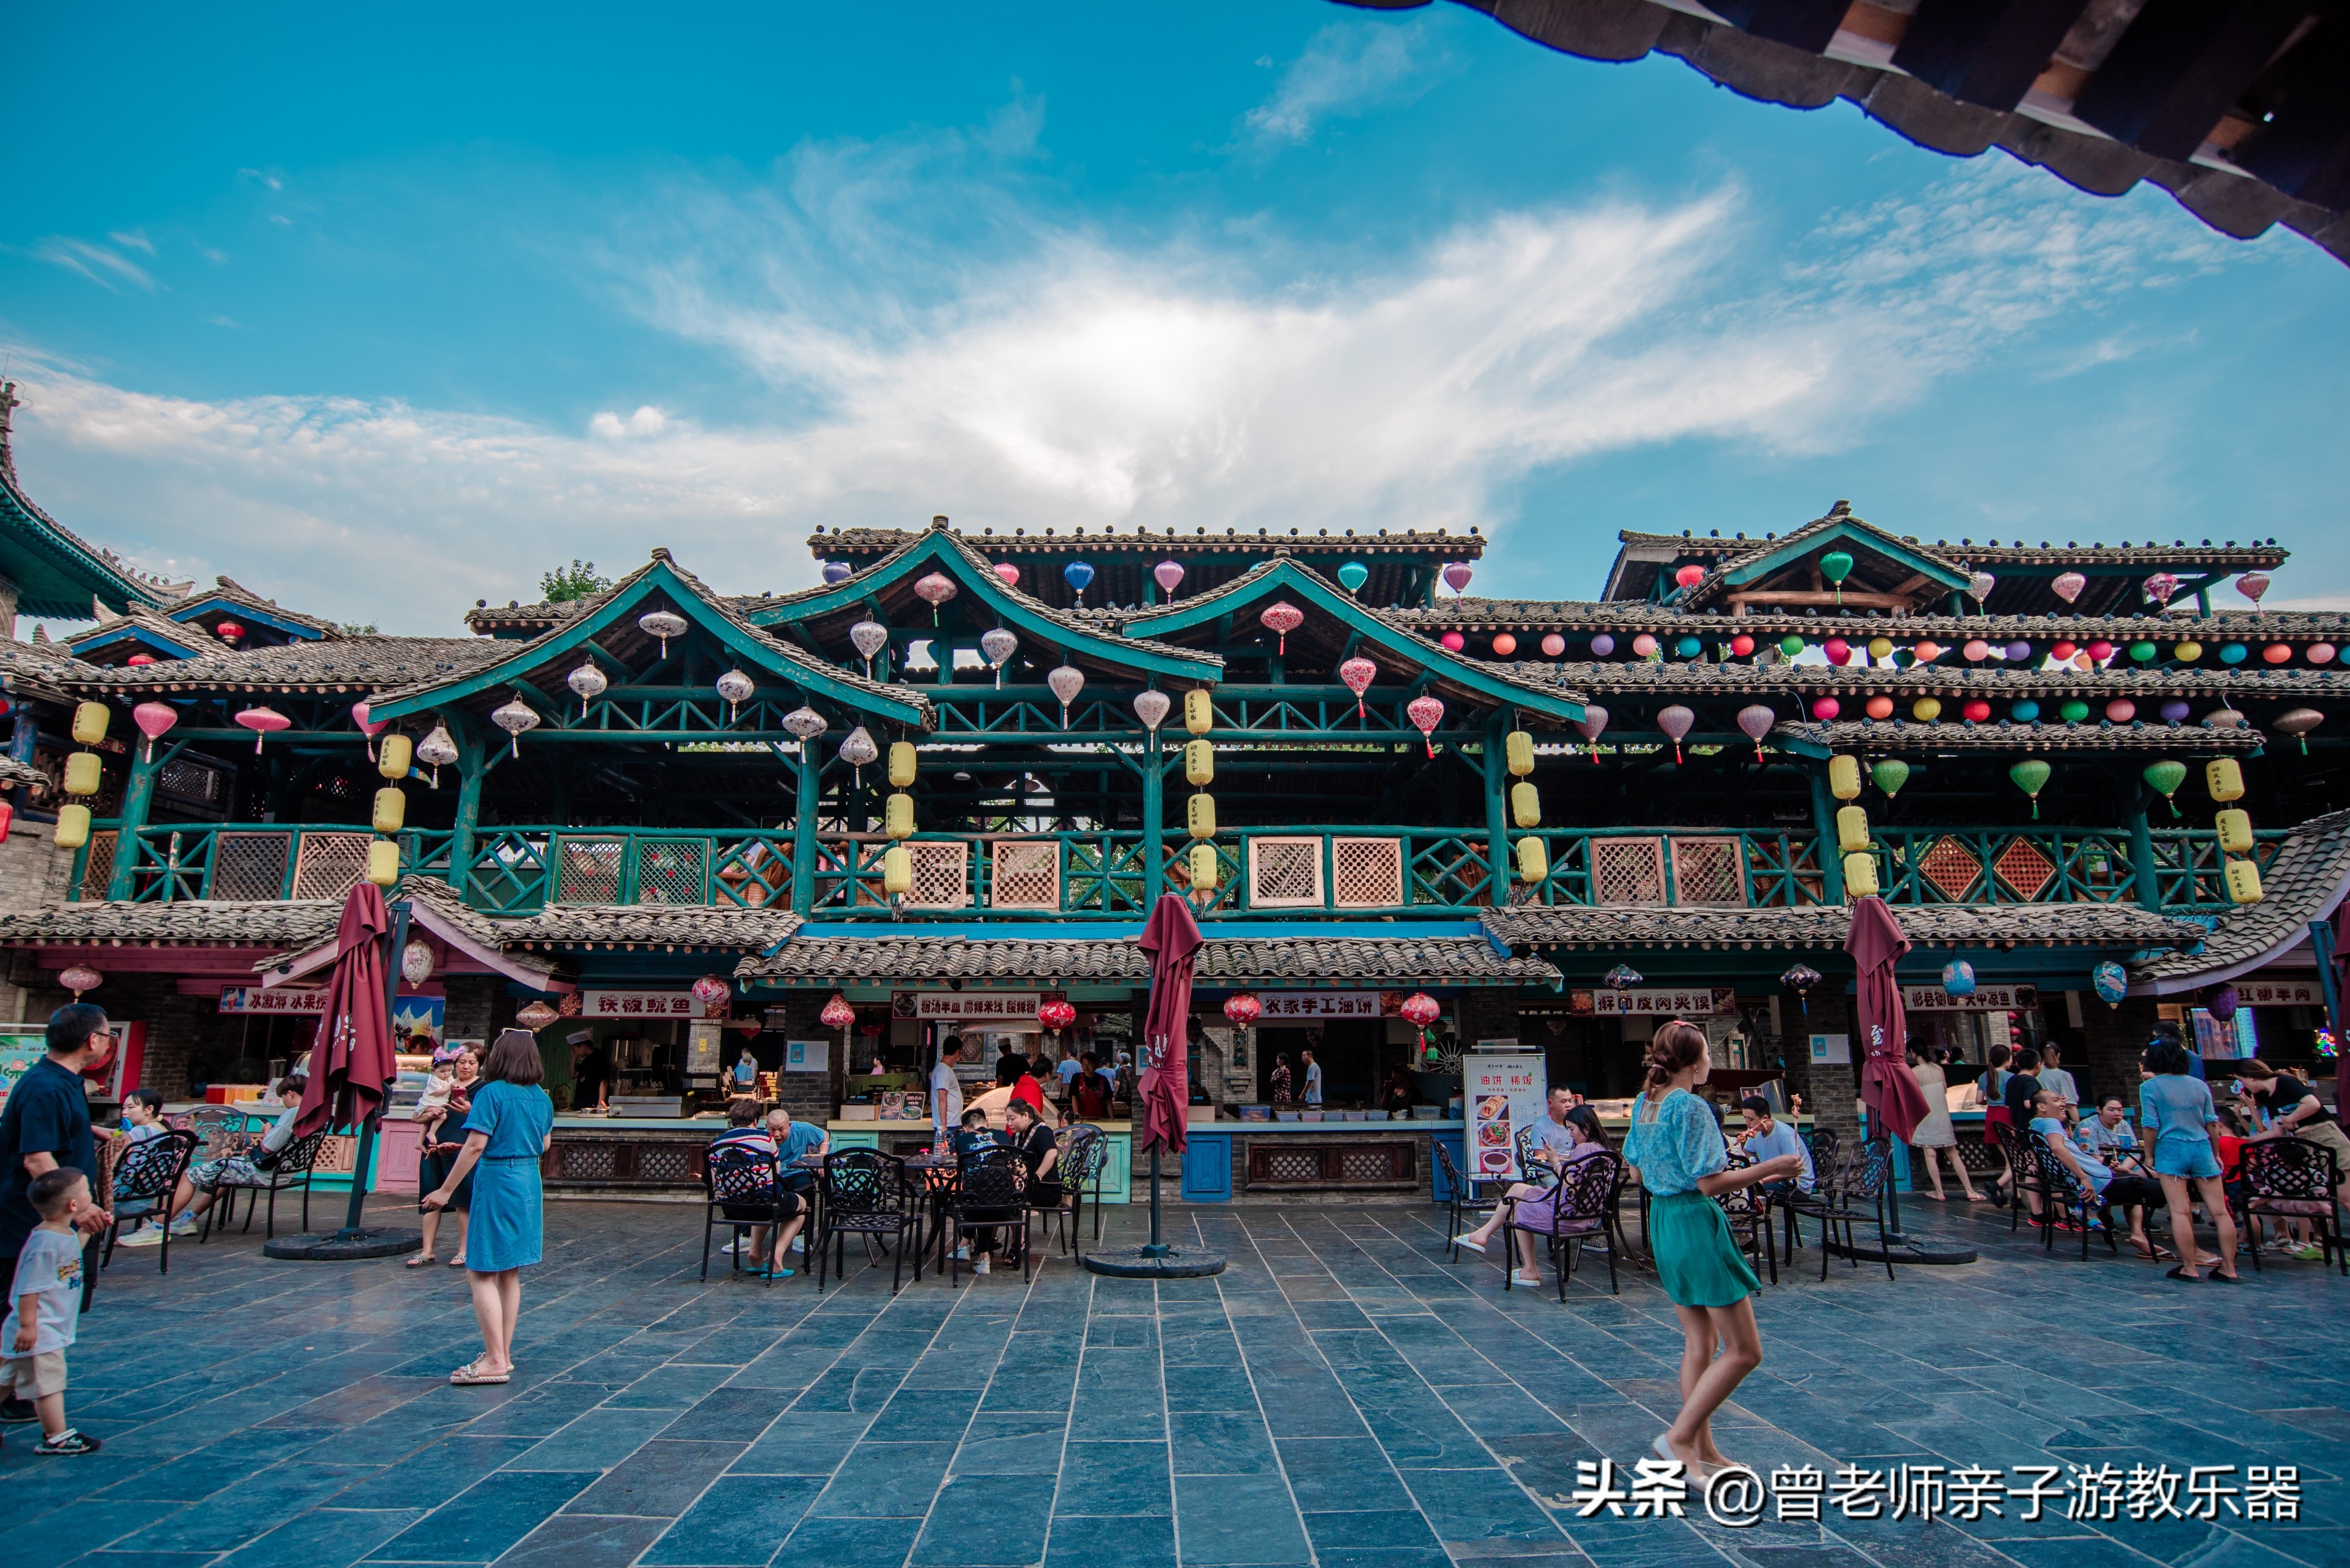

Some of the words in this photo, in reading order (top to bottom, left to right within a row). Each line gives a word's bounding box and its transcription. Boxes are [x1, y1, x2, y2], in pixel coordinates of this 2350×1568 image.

[598, 994, 691, 1013] 铁板鱿鱼
[921, 997, 961, 1014] 粉汤羊血
[964, 998, 1003, 1014] 麻辣米线
[1006, 998, 1037, 1014] 酸辣粉
[1265, 995, 1372, 1014] 农家手工油饼
[1481, 1075, 1502, 1085] 油饼
[1510, 1075, 1533, 1085] 稀饭
